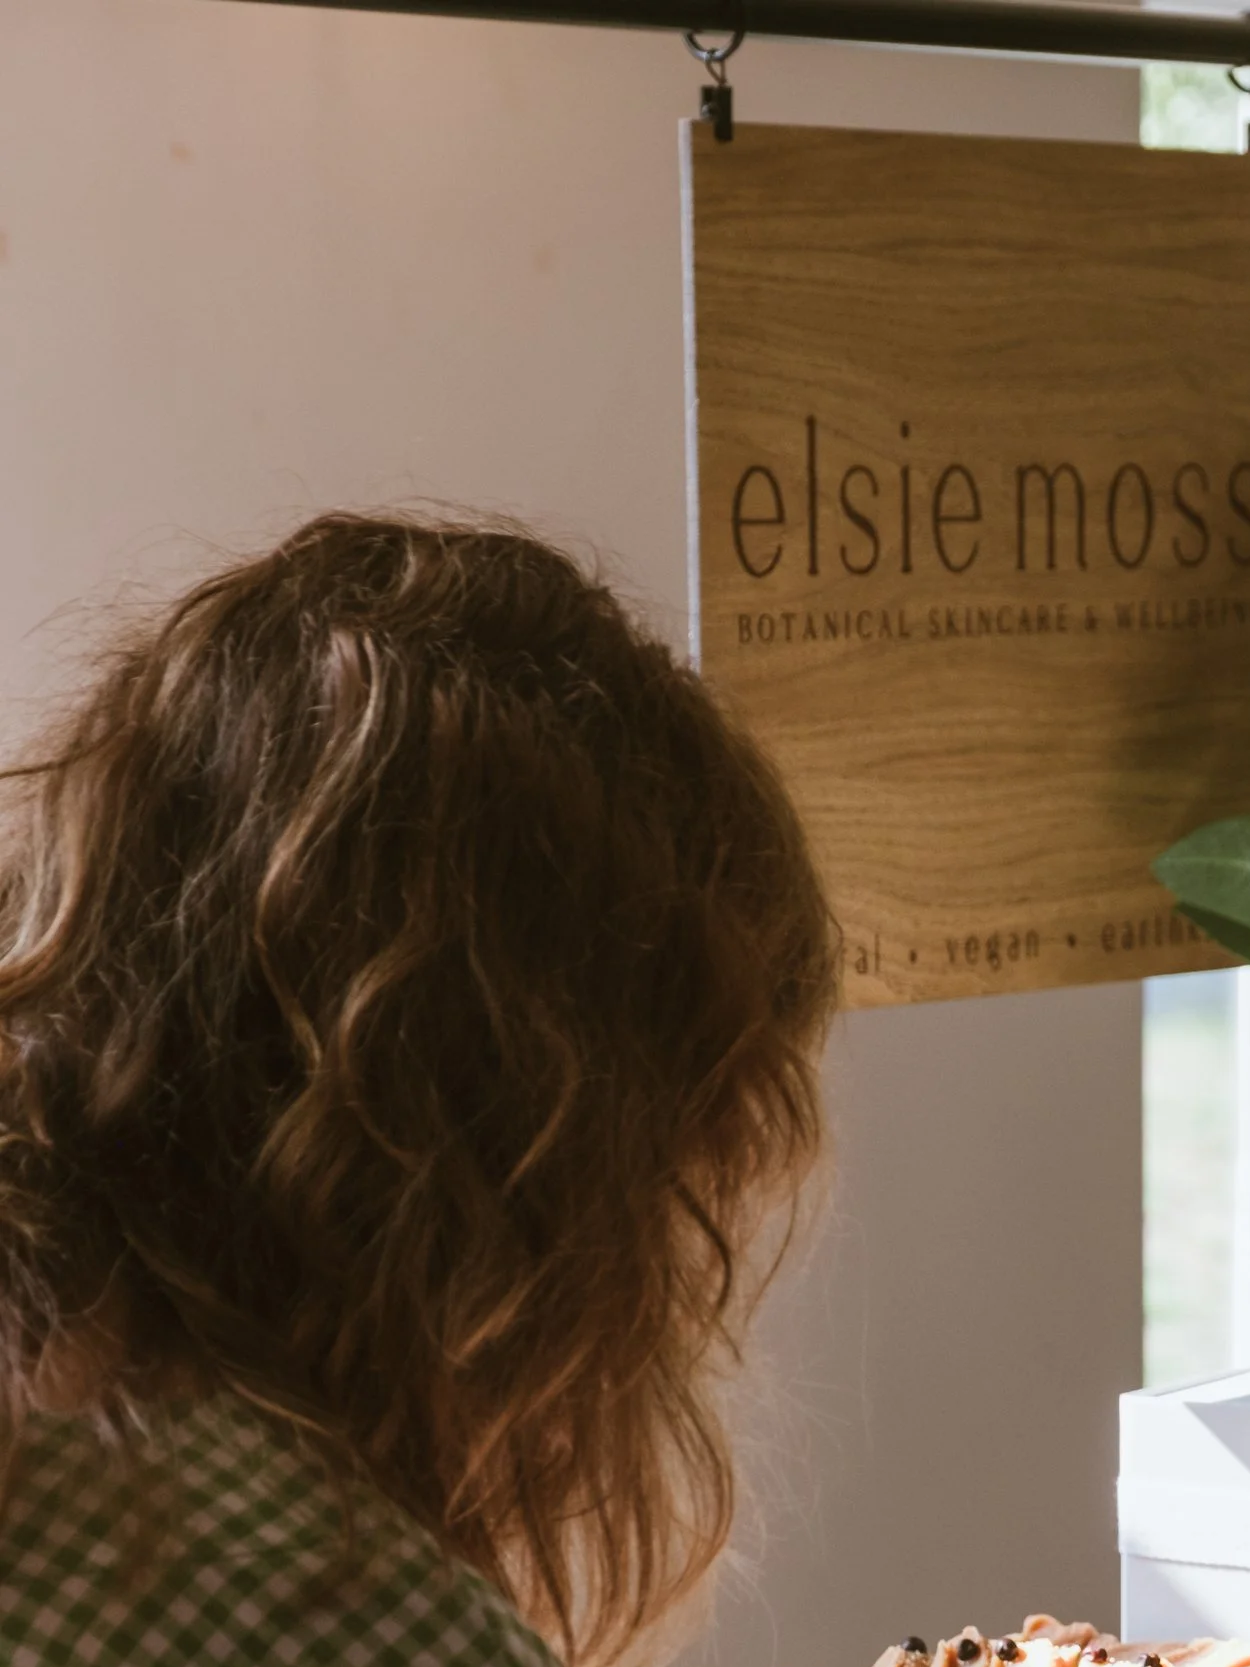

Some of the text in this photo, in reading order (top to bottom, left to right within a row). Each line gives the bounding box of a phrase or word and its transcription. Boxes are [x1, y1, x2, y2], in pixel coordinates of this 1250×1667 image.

[732, 414, 983, 579] elsie
[737, 609, 912, 645] BOTANICAL
[928, 602, 1067, 638] SKINCARE
[1084, 606, 1104, 632] &
[945, 930, 1040, 973] vegan
